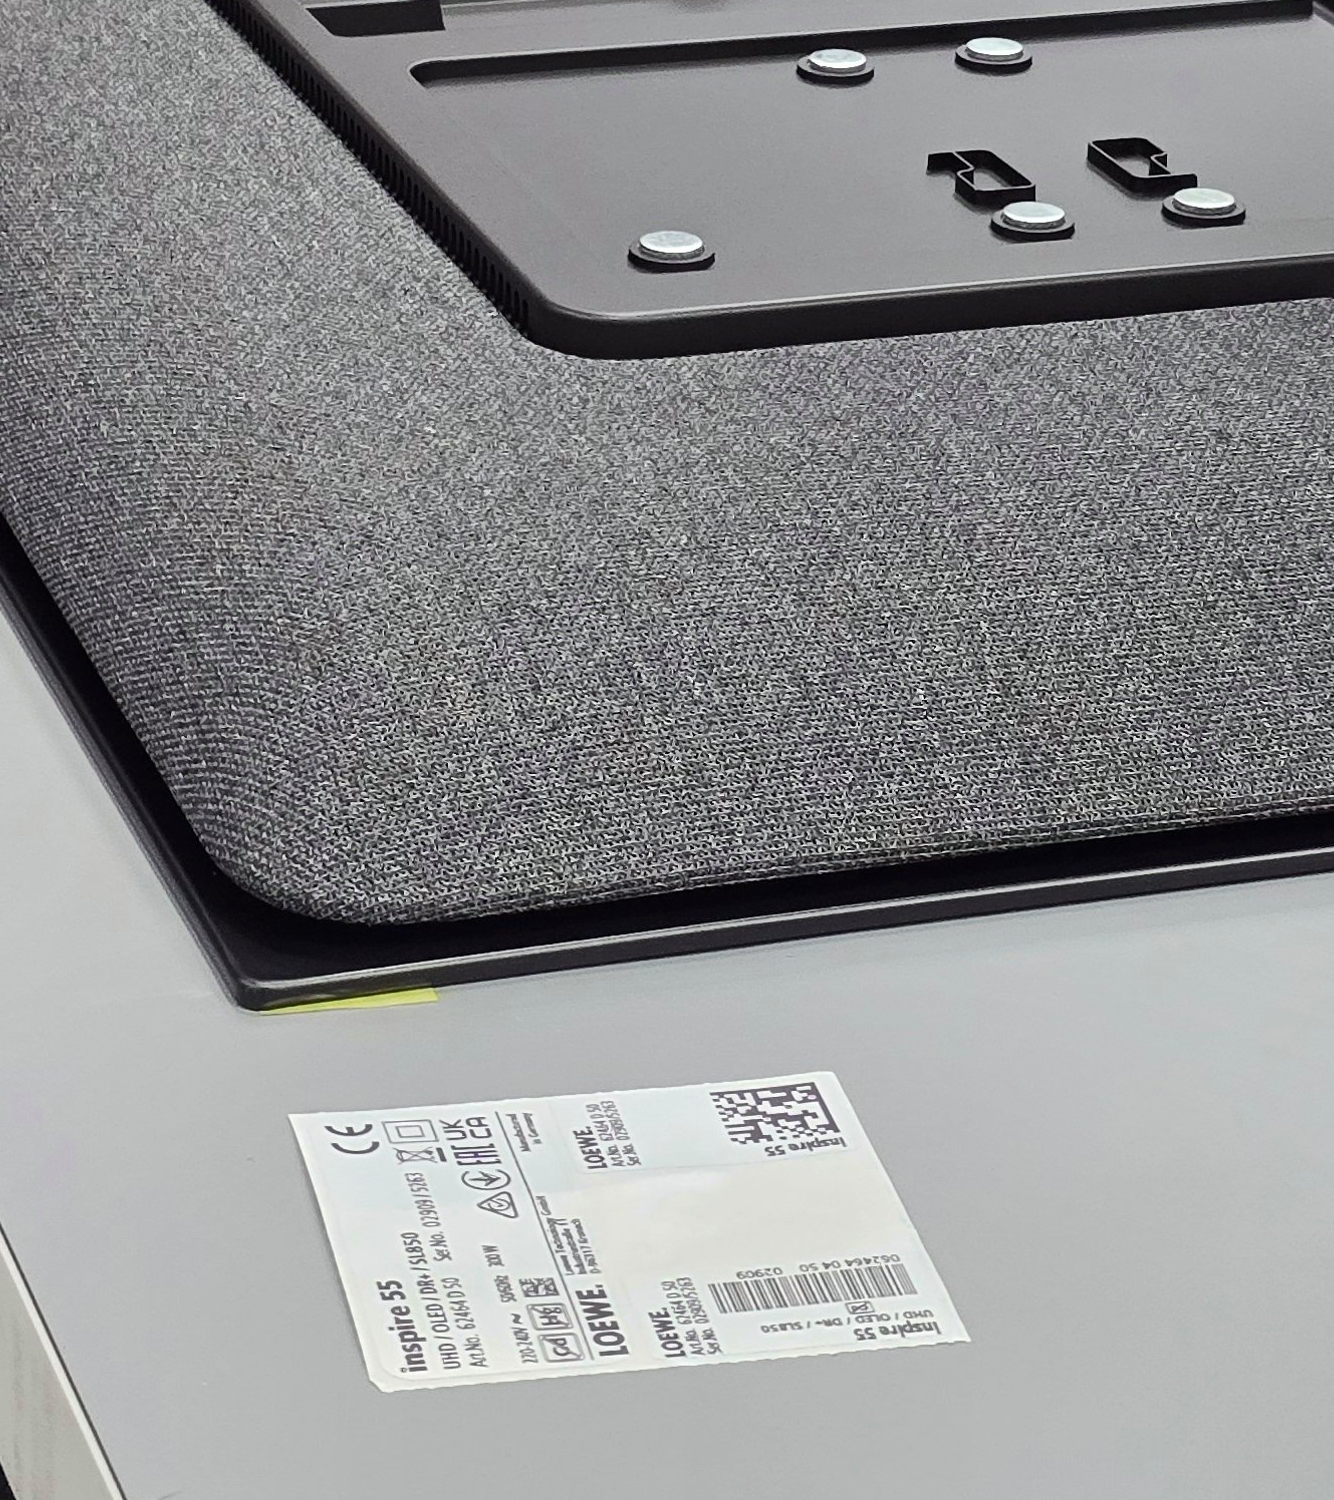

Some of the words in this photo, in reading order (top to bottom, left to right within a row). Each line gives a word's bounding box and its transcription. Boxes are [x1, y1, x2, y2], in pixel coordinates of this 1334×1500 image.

[572, 1126, 608, 1170] LOEWE.
[764, 1144, 786, 1157] 55
[400, 1232, 428, 1265] SL850
[798, 1262, 819, 1273] 50
[821, 1260, 842, 1270] 04
[376, 1280, 407, 1301] 55
[416, 1273, 438, 1295] DR+
[440, 1277, 463, 1289] 50
[446, 1290, 466, 1299] D
[425, 1303, 450, 1333] OLED
[449, 1300, 476, 1330] 62464
[575, 1284, 630, 1357] LOEWE.
[388, 1305, 428, 1373] inspire
[647, 1307, 687, 1358] LOEWE.
[853, 1327, 877, 1341] 55
[437, 1343, 461, 1370] UHD
